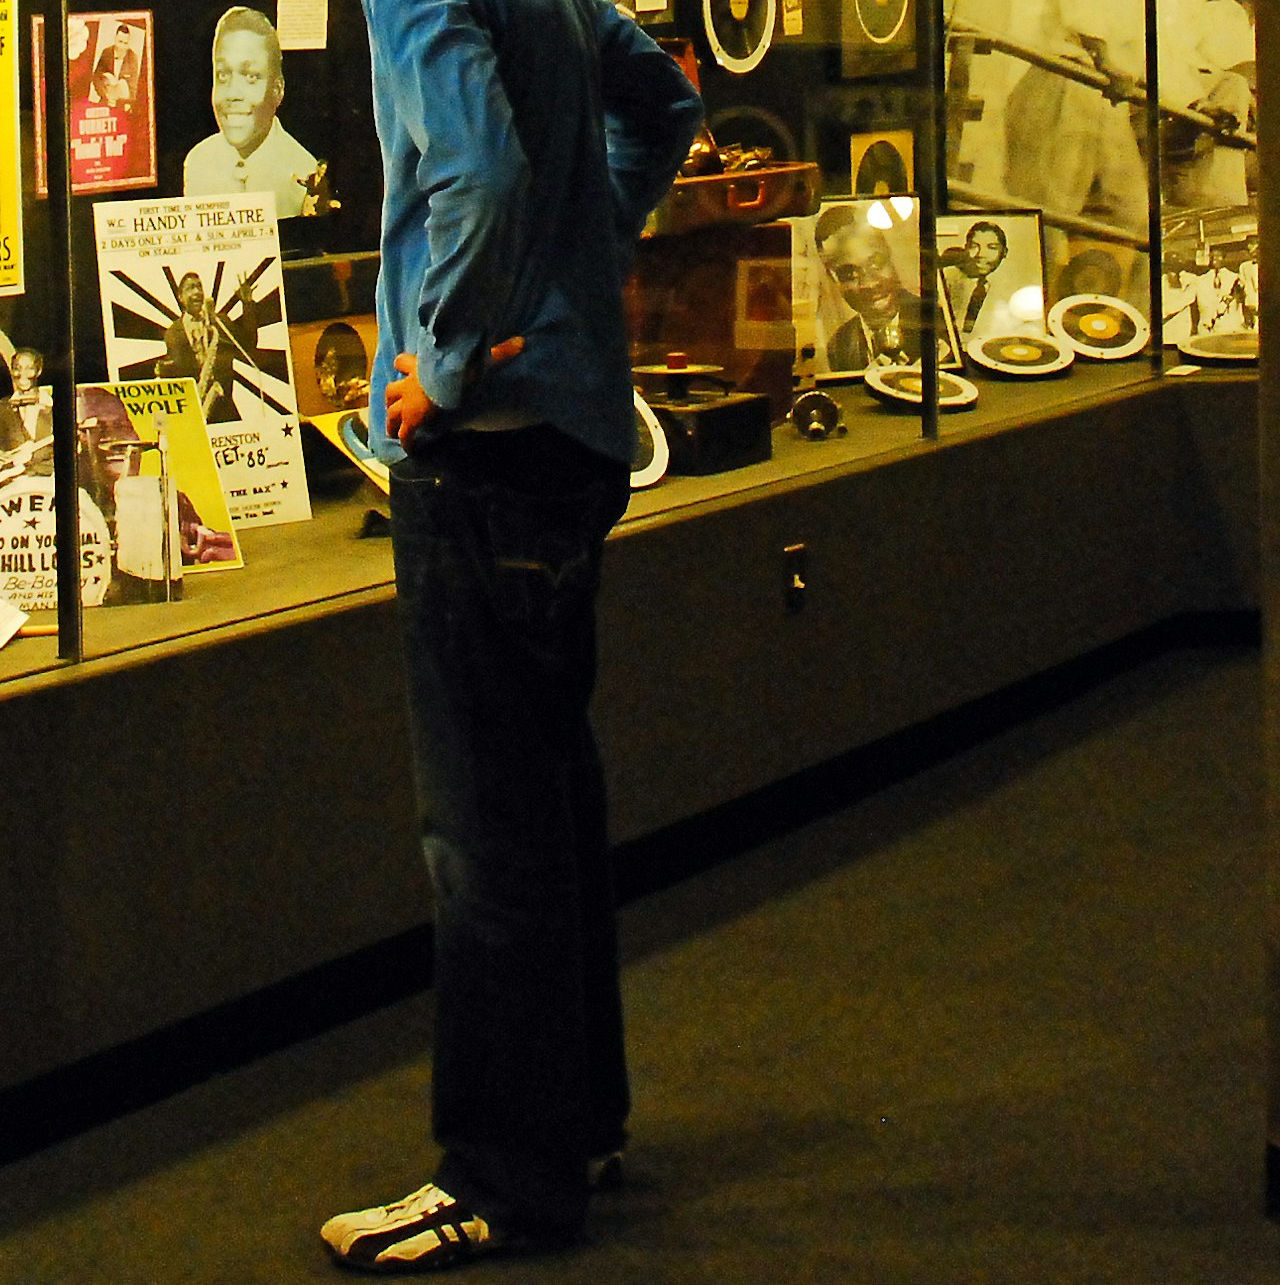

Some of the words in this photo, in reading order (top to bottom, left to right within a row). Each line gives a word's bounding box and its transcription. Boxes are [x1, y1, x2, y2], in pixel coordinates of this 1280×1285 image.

[139, 207, 159, 215] FIRST
[133, 215, 187, 232] HANDY
[197, 209, 264, 227] THEATRE
[101, 241, 107, 249] 2
[111, 238, 136, 249] DAYS
[138, 237, 162, 247] ONLY
[231, 228, 257, 239] APRIL
[139, 249, 150, 258] ON
[153, 247, 178, 256] STAGE
[127, 398, 188, 416] WOLF
[211, 432, 260, 448] RENSTON
[230, 489, 248, 498] THE
[11, 535, 30, 549] ON
[35, 535, 57, 548] YO
[0, 553, 36, 572] HILL
[3, 576, 57, 591] Be-Bo
